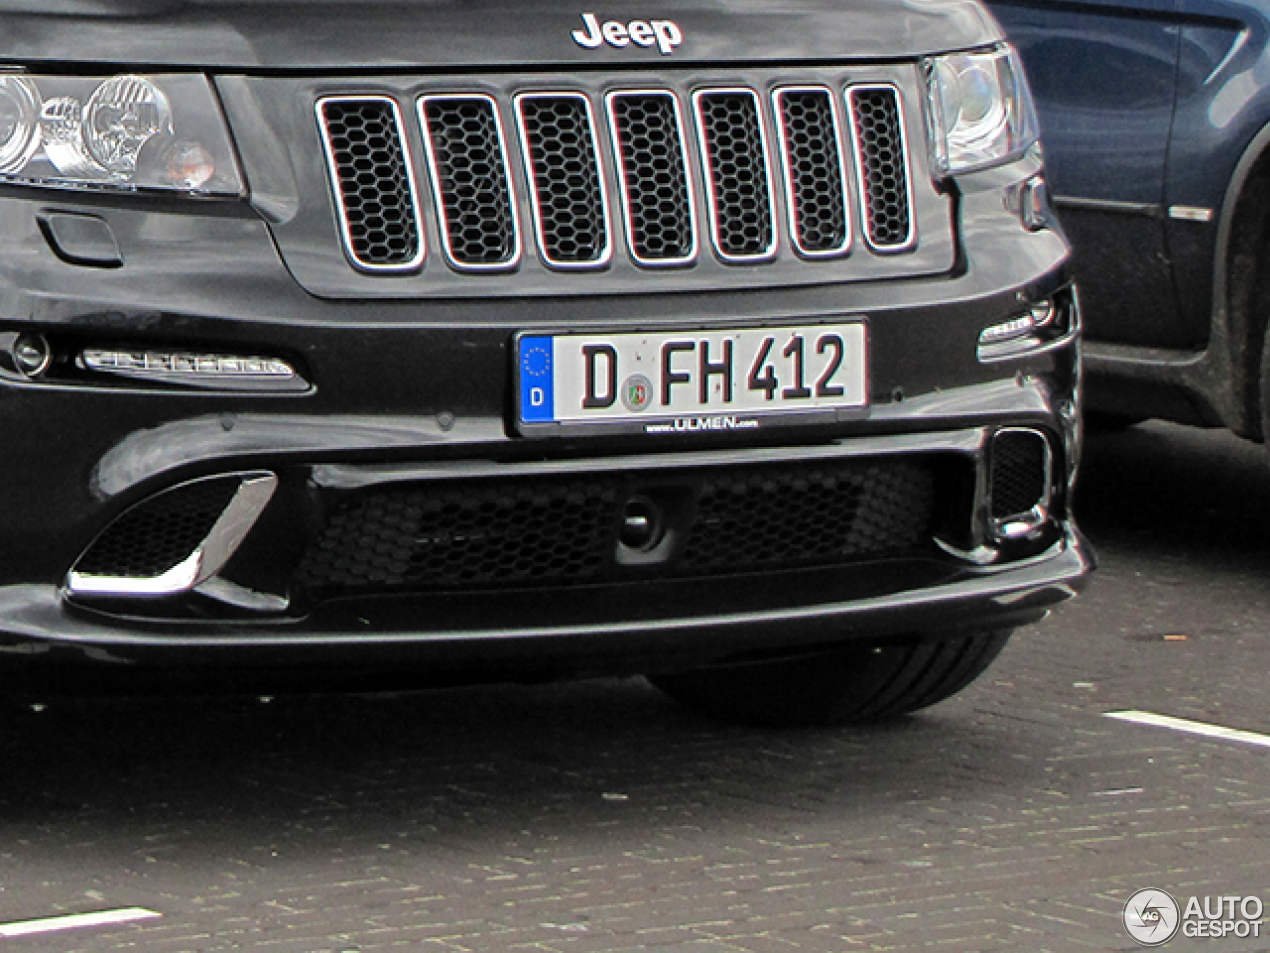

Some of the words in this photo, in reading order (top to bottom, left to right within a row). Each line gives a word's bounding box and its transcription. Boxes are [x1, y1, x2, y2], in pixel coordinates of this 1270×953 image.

[571, 12, 685, 56] Jeep
[581, 344, 618, 410] D
[661, 339, 733, 407] FH
[748, 333, 845, 402] 412
[530, 388, 544, 407] D
